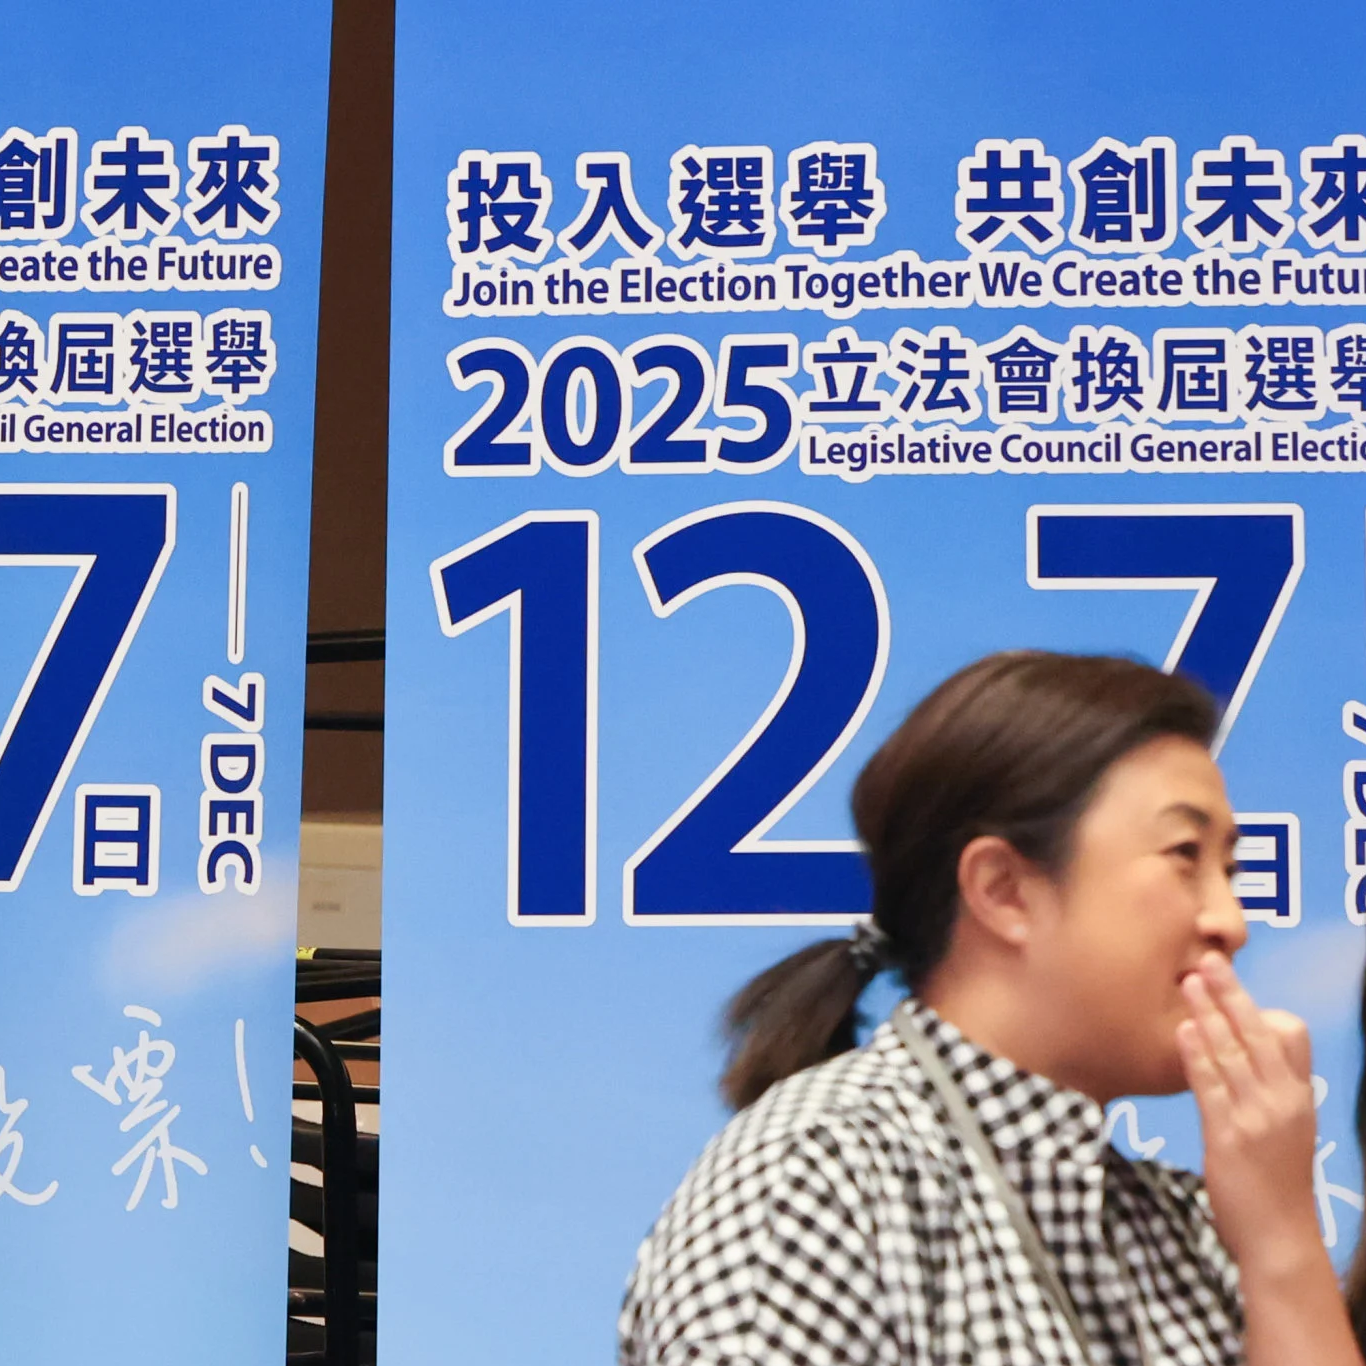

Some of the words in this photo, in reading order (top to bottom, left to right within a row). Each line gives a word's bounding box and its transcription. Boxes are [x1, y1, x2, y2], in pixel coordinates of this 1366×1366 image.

[457, 152, 875, 254] 投入選舉
[87, 245, 148, 281] the
[158, 247, 273, 281] Future
[453, 270, 534, 307] Join
[544, 268, 609, 305] the
[621, 266, 776, 303] Election
[785, 261, 971, 309] Together
[979, 262, 1042, 297] We
[1053, 261, 1183, 297] Create
[1193, 259, 1261, 295] the
[454, 344, 792, 466] 2025
[24, 413, 142, 443] General
[151, 413, 264, 443] Election
[810, 433, 992, 472] Legislative
[1000, 432, 1121, 463] Council
[1130, 431, 1261, 462] General
